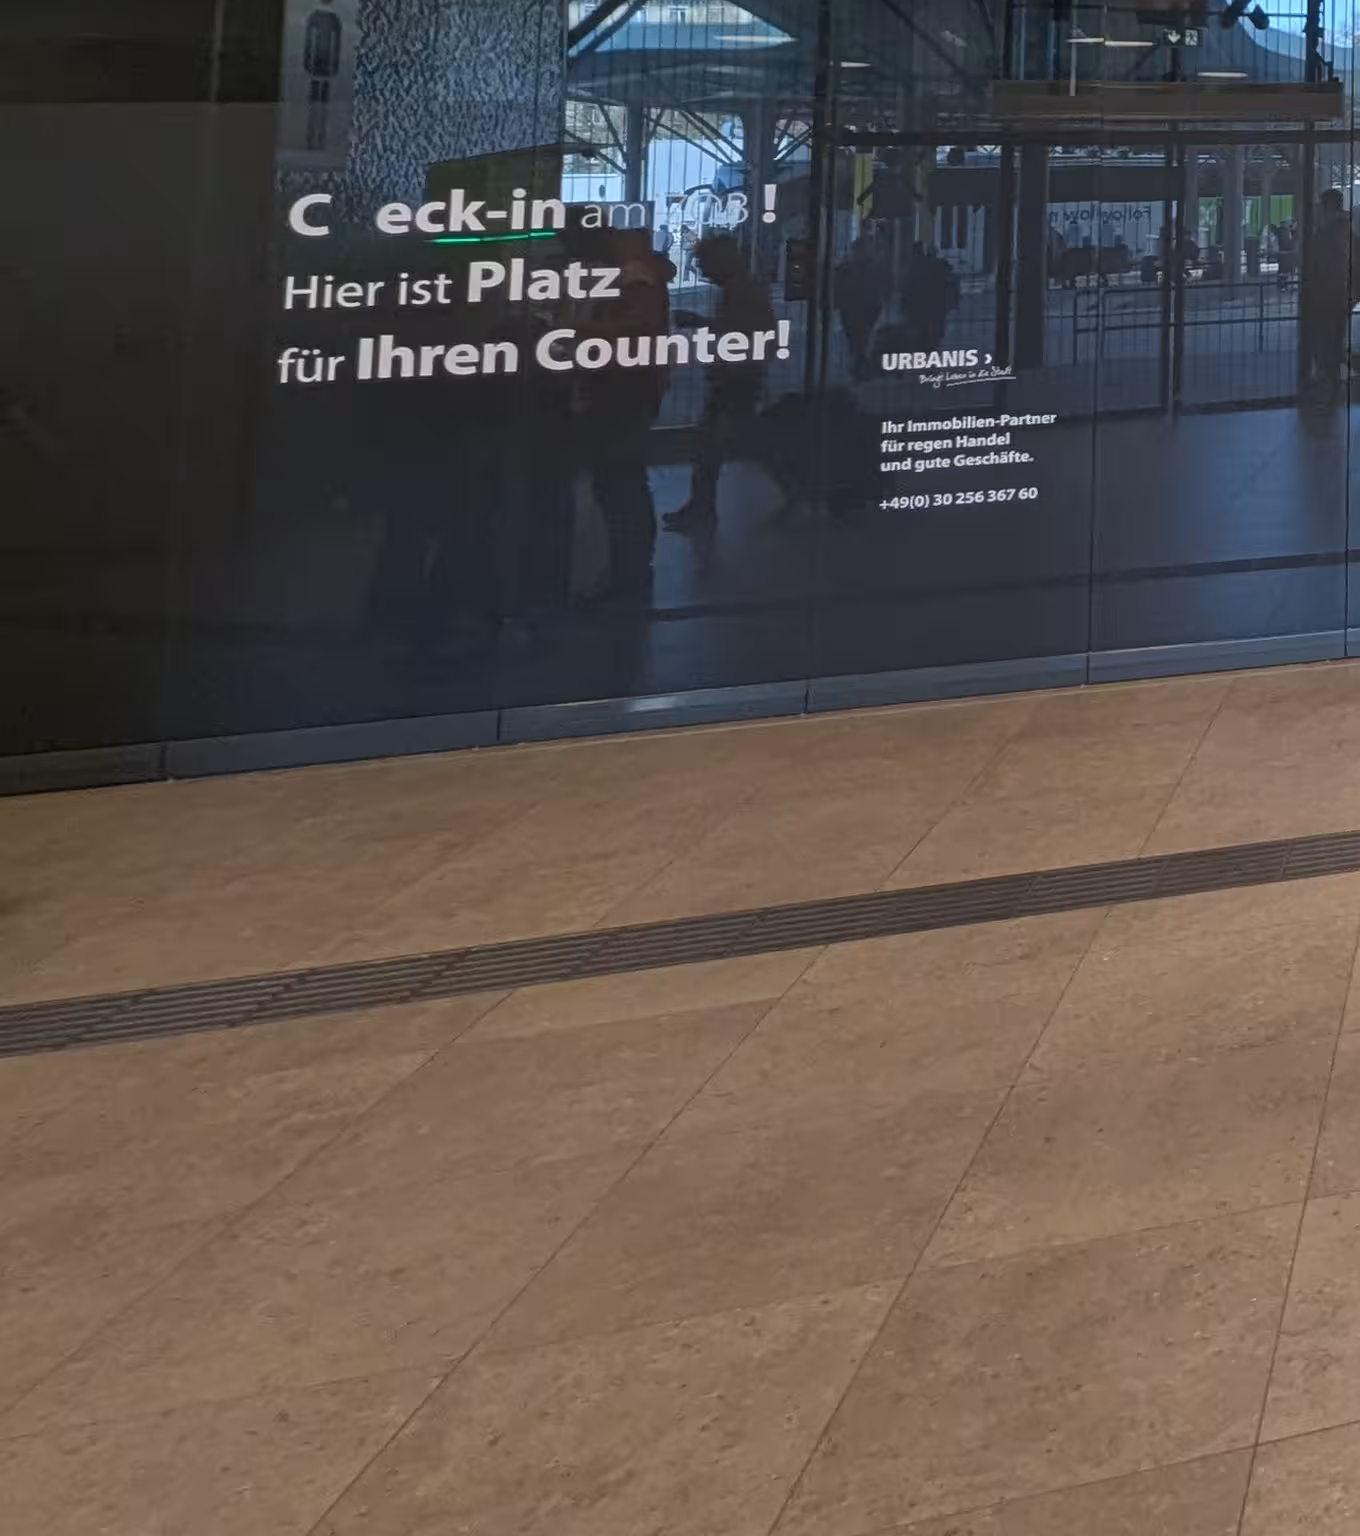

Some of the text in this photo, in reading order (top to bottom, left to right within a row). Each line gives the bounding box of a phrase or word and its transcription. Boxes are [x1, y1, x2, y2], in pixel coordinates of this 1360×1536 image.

[289, 188, 566, 236] Ceck-in
[581, 204, 645, 229] am
[284, 258, 621, 309] Hier ist Platz
[278, 320, 791, 384] für Ihren Counter!
[882, 350, 978, 371] URBANIS
[881, 414, 1057, 434] Ihr Immobilien-Partner
[880, 432, 1011, 453] für regen Handel
[880, 450, 1035, 473] und gute Geschäfte.
[879, 487, 1039, 510] +49(0) 30 256 367 60
